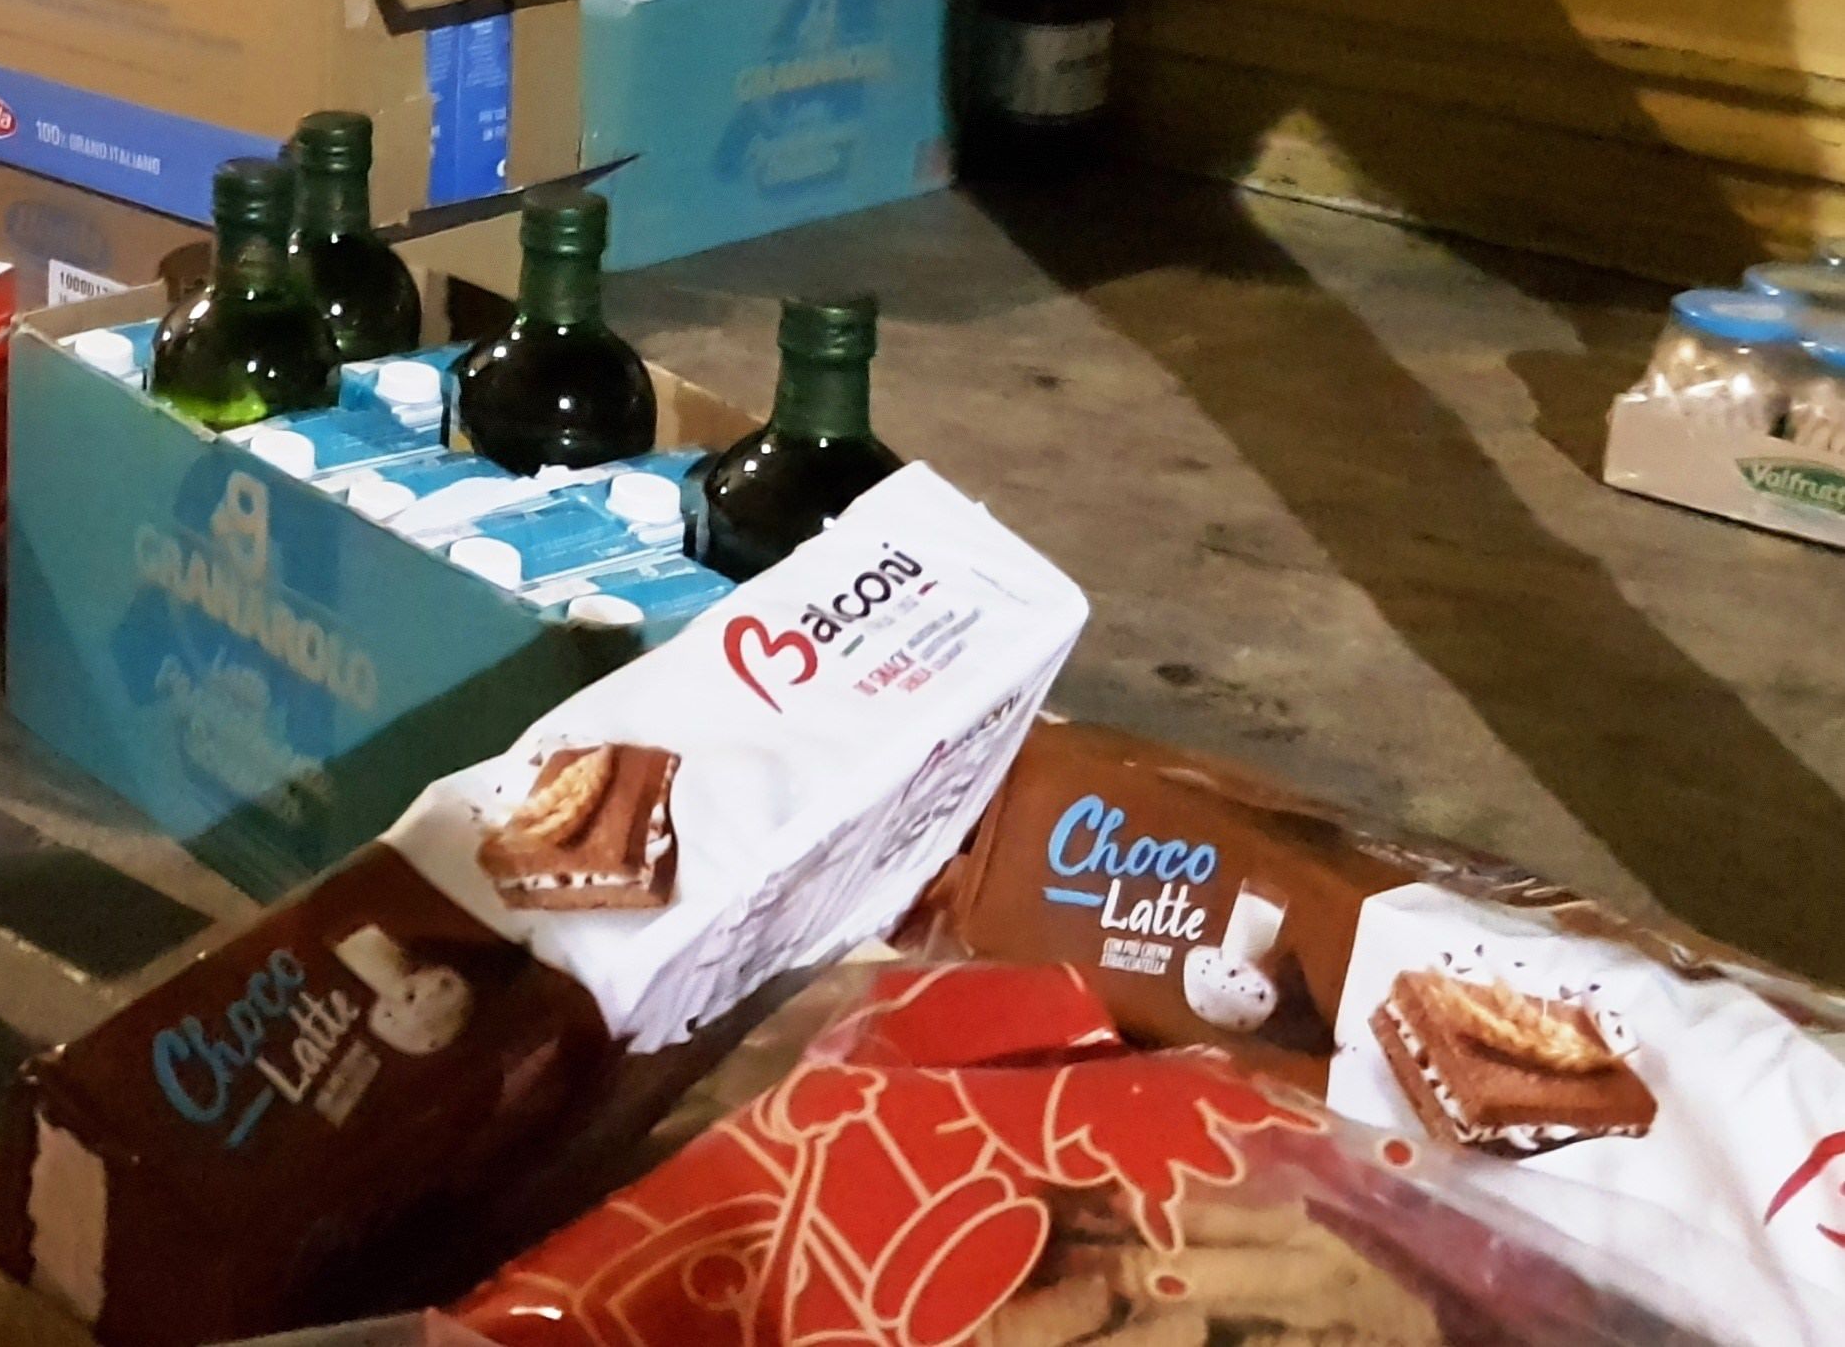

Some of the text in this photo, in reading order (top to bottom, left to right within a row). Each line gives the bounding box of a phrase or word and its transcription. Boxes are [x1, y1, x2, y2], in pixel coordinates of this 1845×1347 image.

[108, 139, 162, 176] ITALIANO
[723, 541, 923, 715] Balconi
[1048, 794, 1217, 885] Choco
[1100, 878, 1207, 941] Latte
[152, 949, 305, 1124] Choco
[255, 989, 360, 1103] Latte
